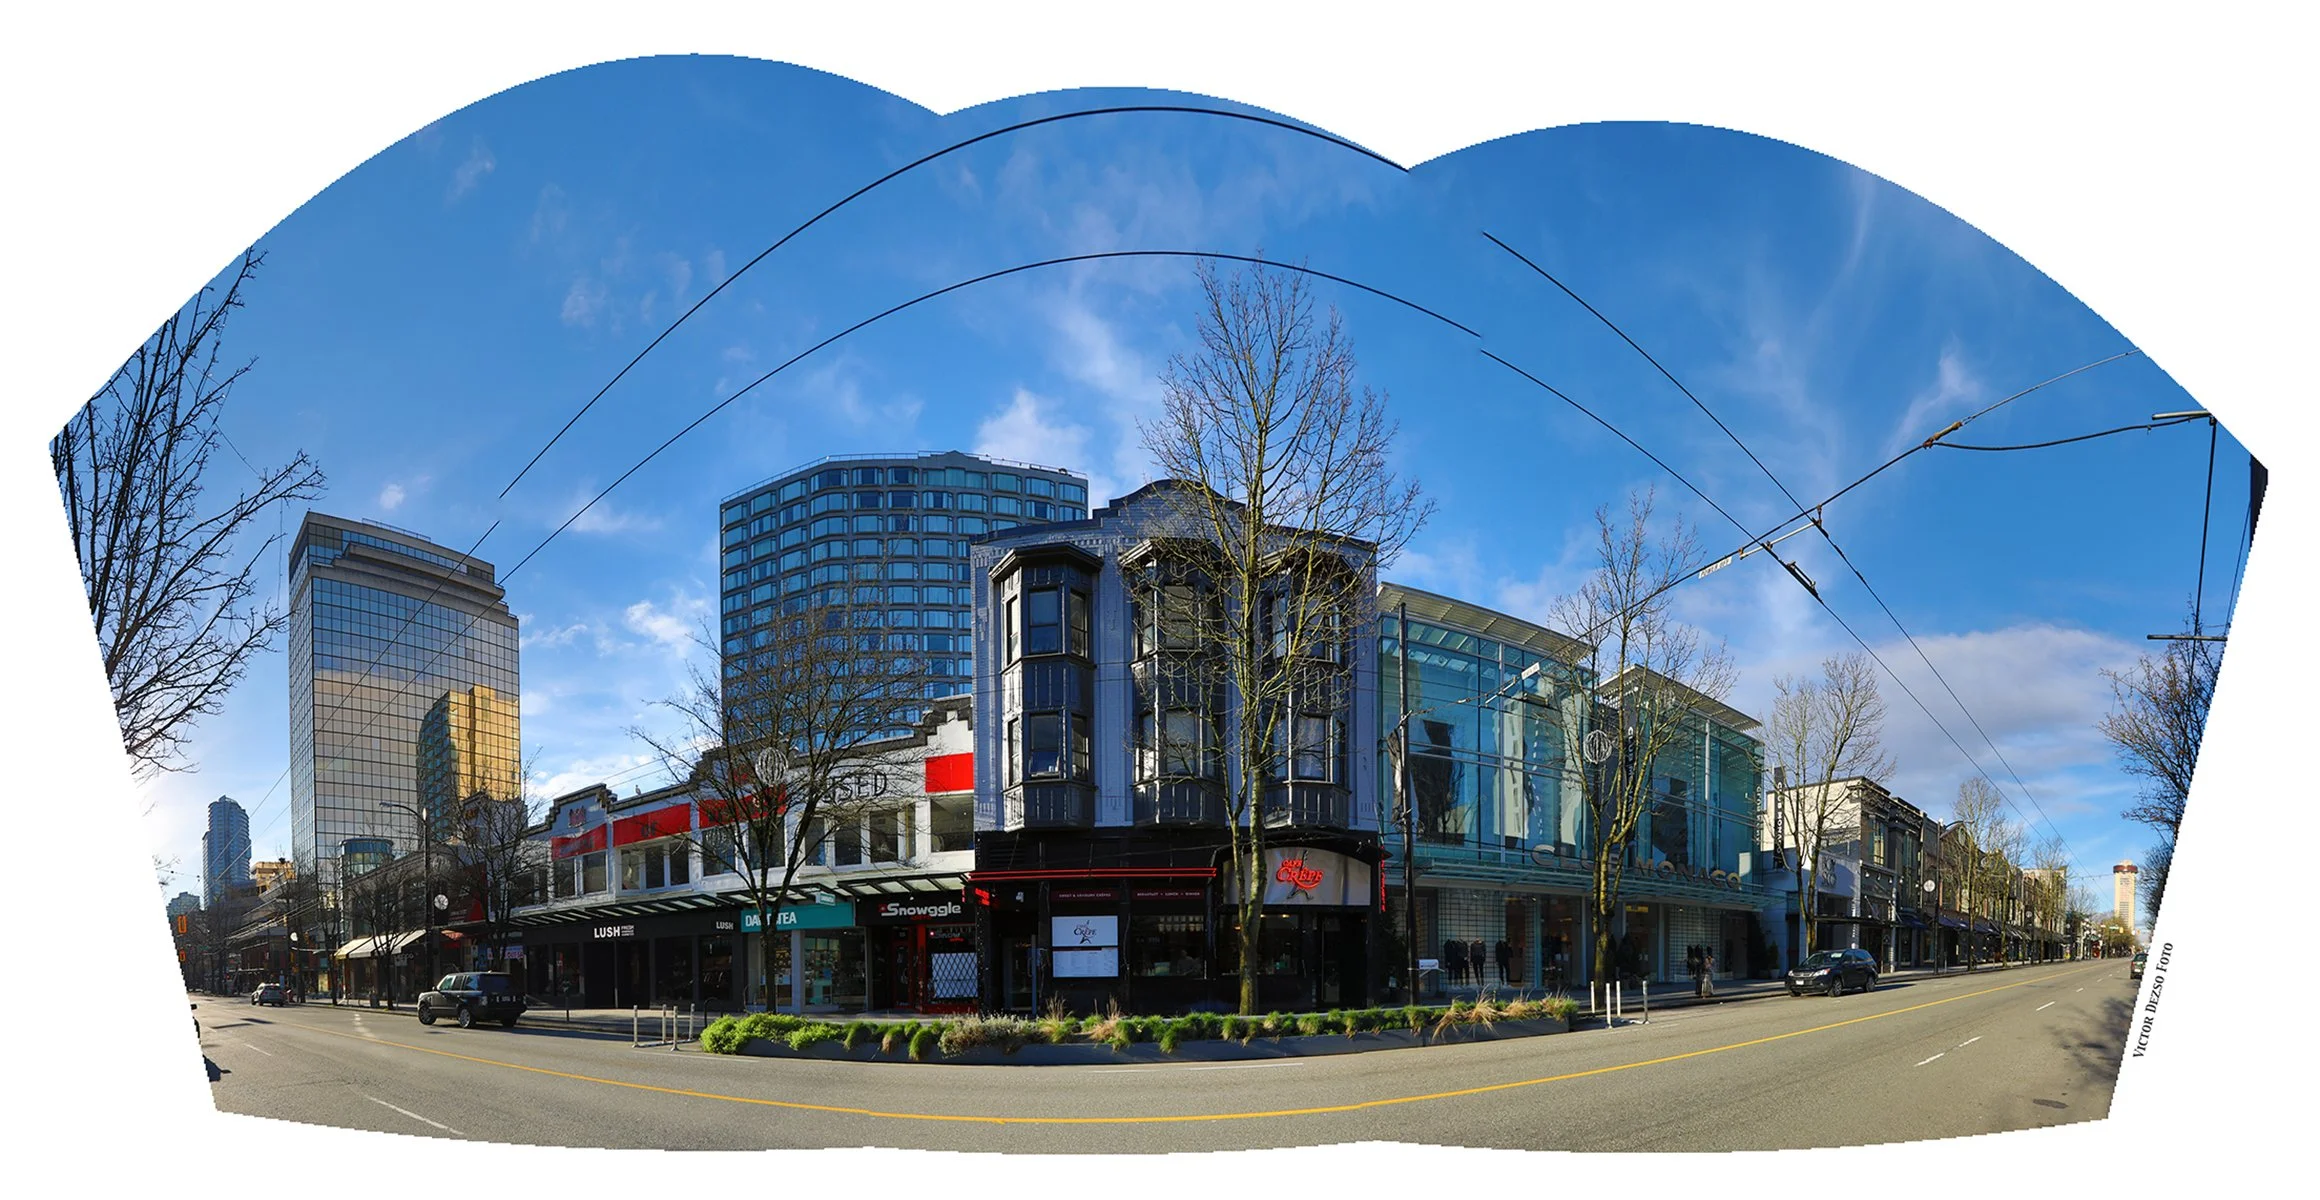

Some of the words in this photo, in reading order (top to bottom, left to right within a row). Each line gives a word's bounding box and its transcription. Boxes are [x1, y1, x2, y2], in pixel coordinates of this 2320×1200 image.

[1634, 856, 1742, 890] MONACO
[881, 902, 962, 917] Snowggle
[594, 926, 620, 938] LUSH
[716, 921, 734, 930] LUSH
